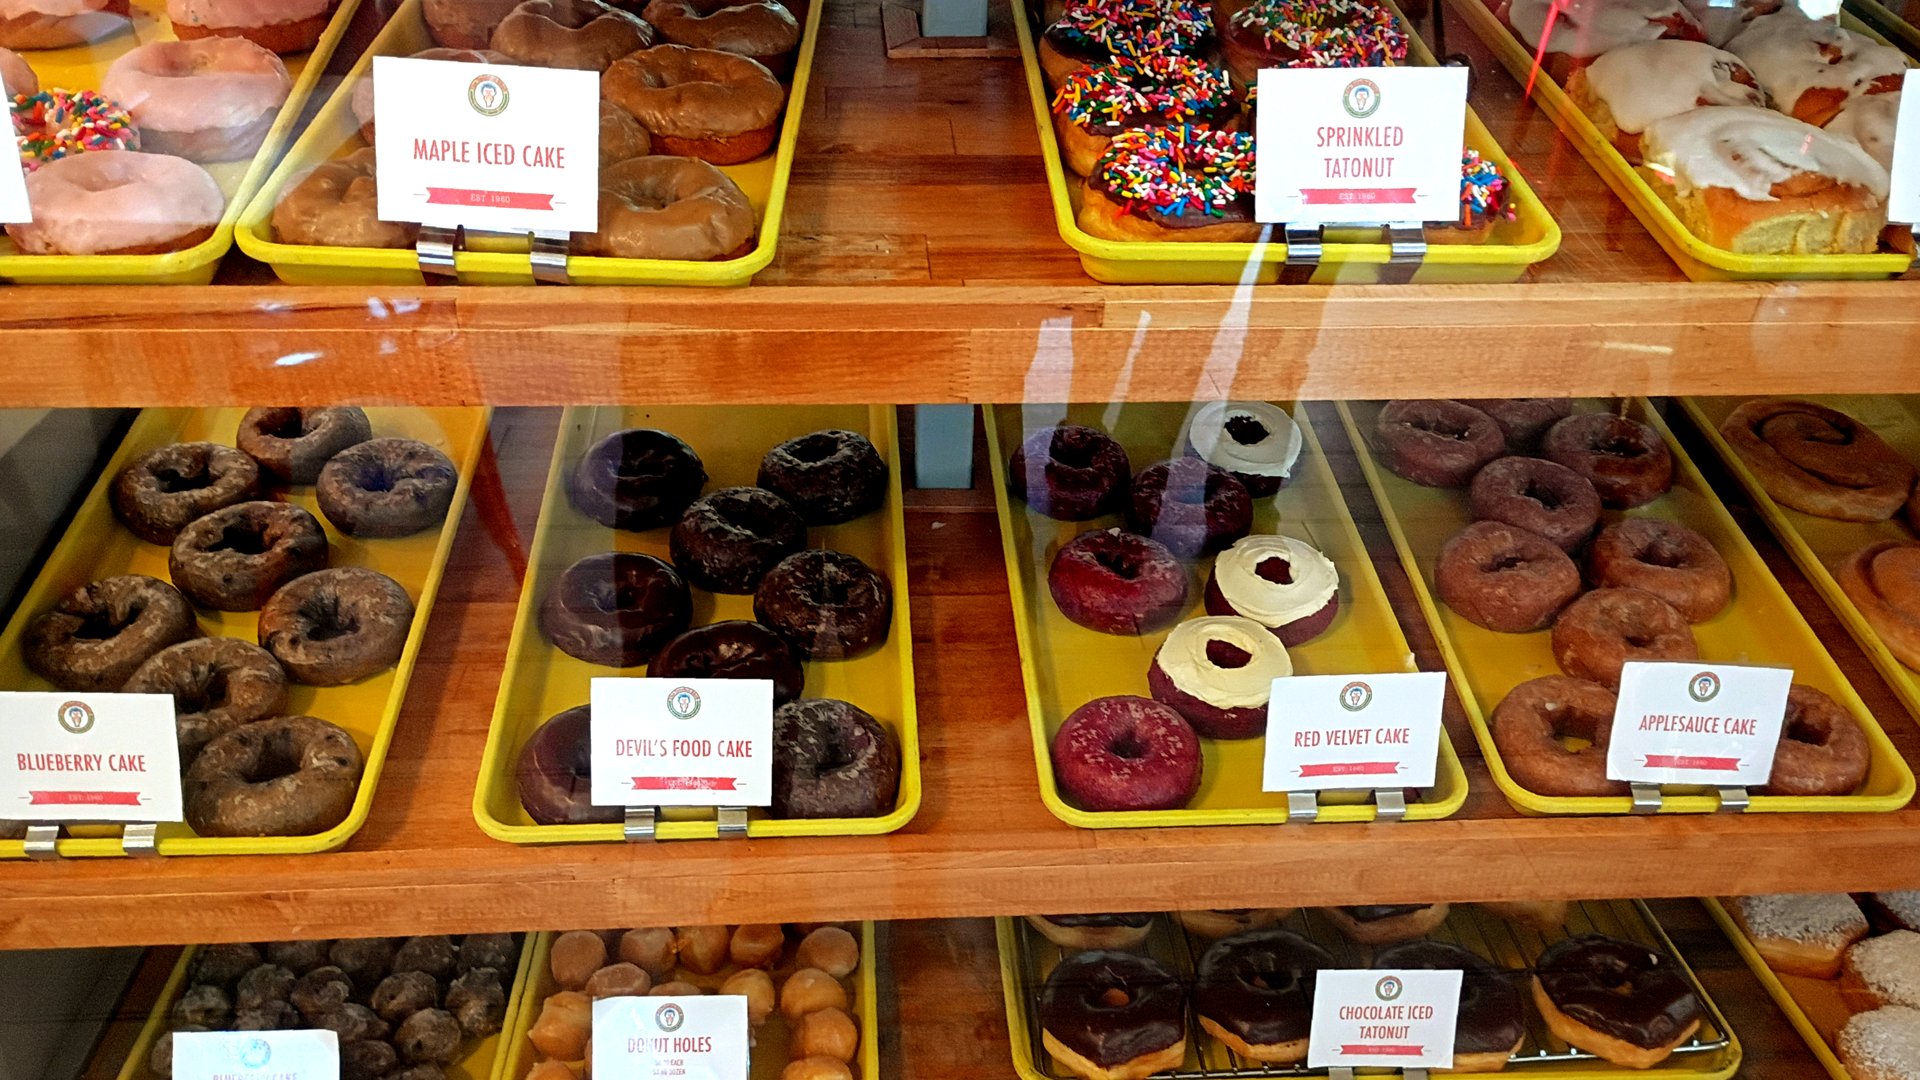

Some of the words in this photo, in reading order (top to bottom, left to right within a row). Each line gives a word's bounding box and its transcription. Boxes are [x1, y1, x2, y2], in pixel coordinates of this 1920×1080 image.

[1316, 126, 1404, 147] SPRINKLED
[413, 138, 470, 163] MAPLE
[477, 142, 515, 166] ICED
[522, 145, 566, 169] CAKE
[1323, 157, 1395, 178] TATONUT
[1638, 714, 1720, 734] APPLESAUCE
[1724, 717, 1758, 736] CAKE
[1294, 731, 1321, 748] RED
[1326, 728, 1371, 746] VELVET
[1375, 727, 1410, 745] CAKE
[616, 739, 667, 757] DEVIL'S
[673, 739, 711, 757] FOOD
[717, 740, 753, 758] CAKE
[17, 753, 102, 772] BLUEBERRY
[108, 754, 147, 772] CAKE
[1339, 1006, 1404, 1020] CHOCOLATE
[1408, 1006, 1434, 1020] ICED
[1359, 1026, 1411, 1039] TATONUT
[673, 1036, 712, 1053] HOLES
